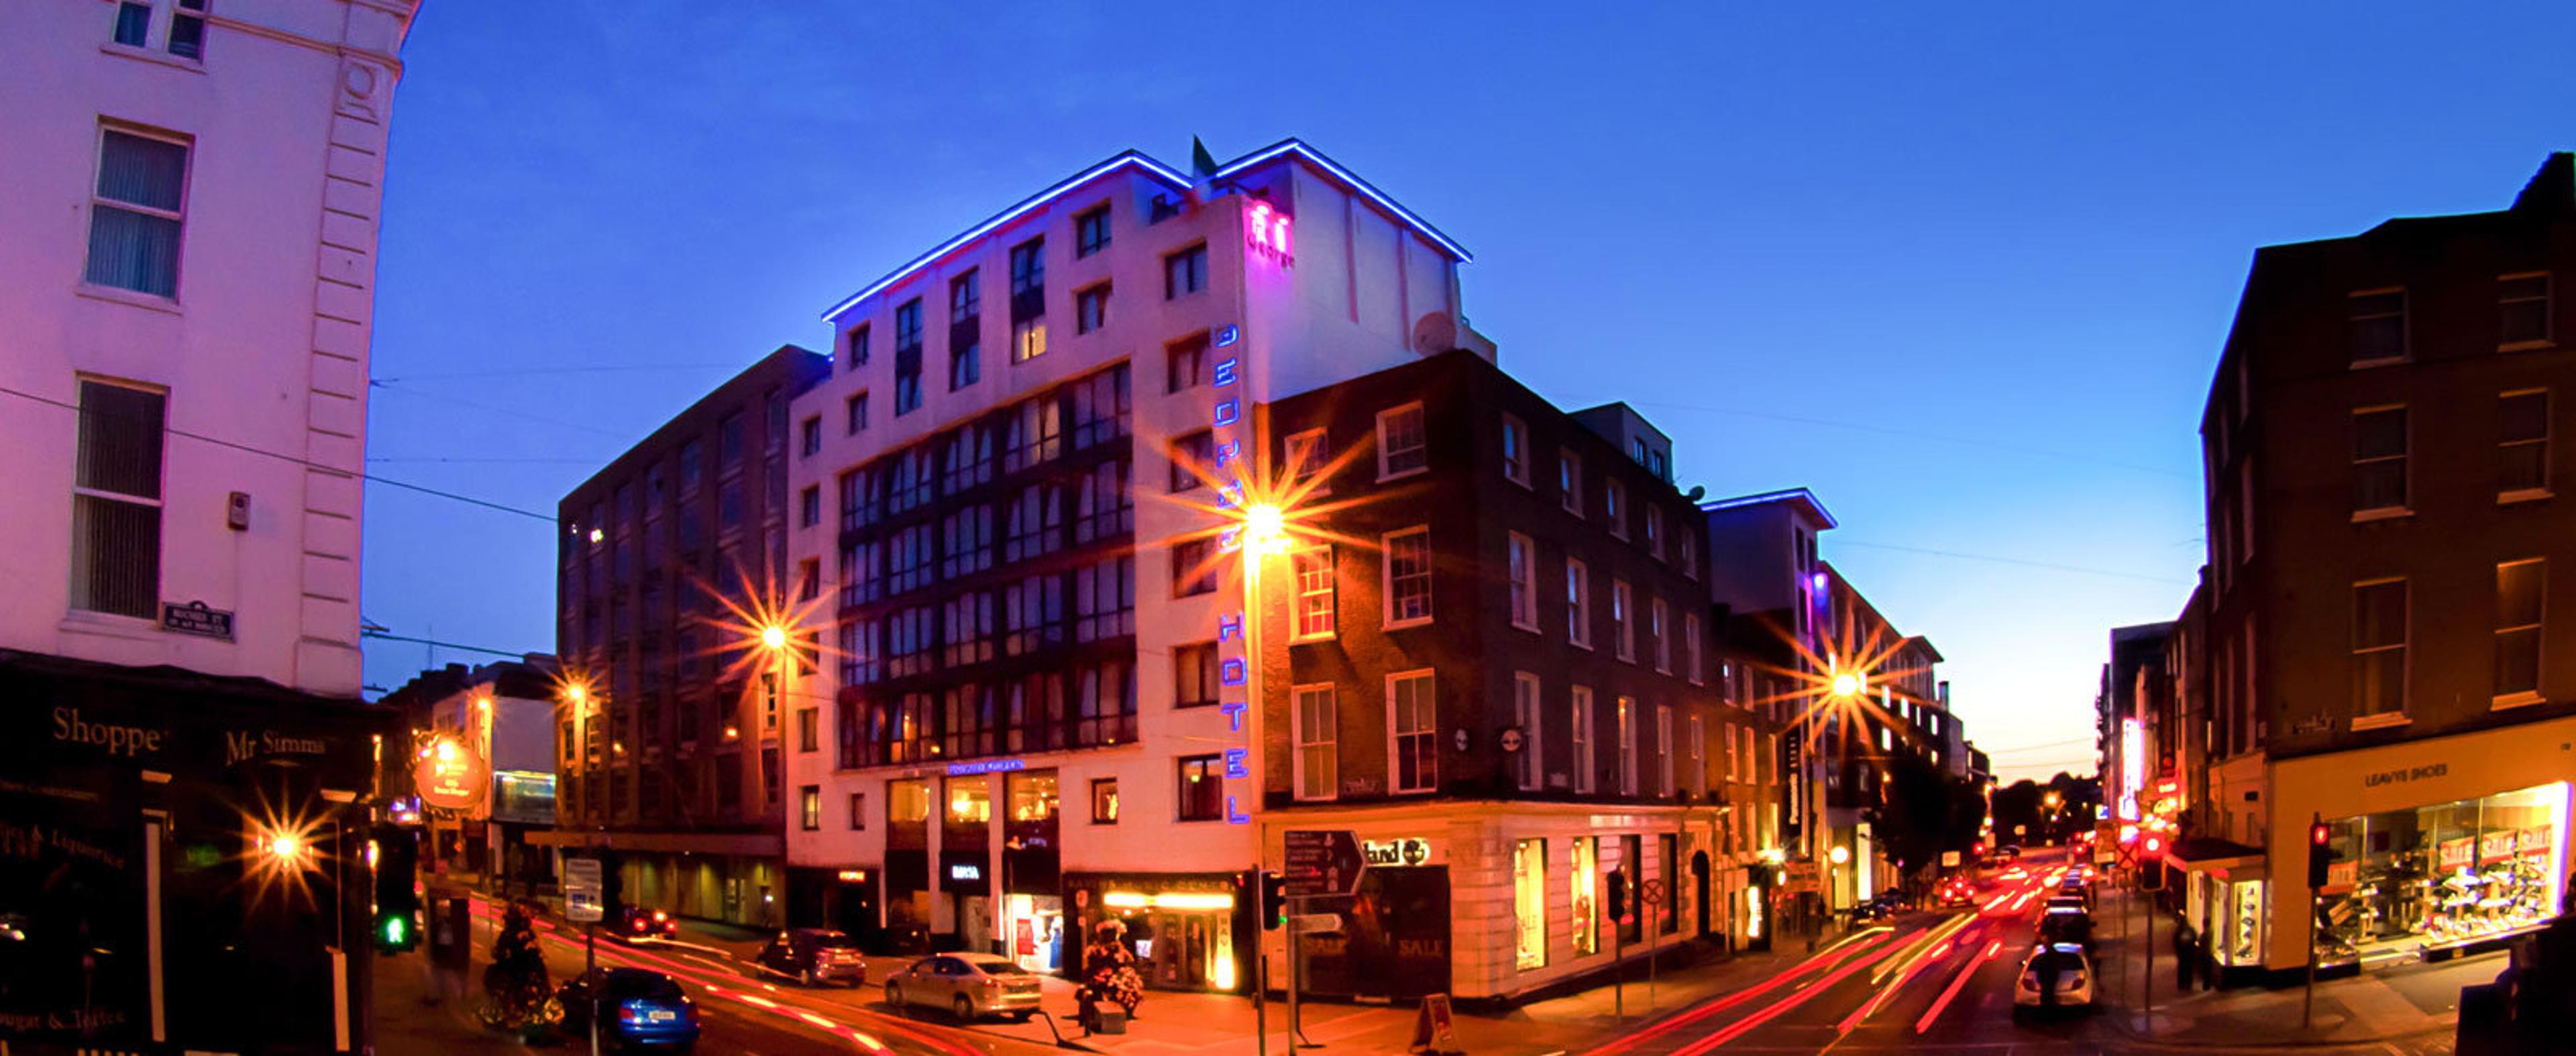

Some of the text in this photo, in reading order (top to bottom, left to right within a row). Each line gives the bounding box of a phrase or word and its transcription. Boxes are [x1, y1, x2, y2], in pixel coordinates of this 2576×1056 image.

[1218, 611, 1250, 825] HOTEL
[225, 728, 257, 767] Mr
[2411, 763, 2447, 780] SHOES
[2481, 836, 2515, 859] SALE
